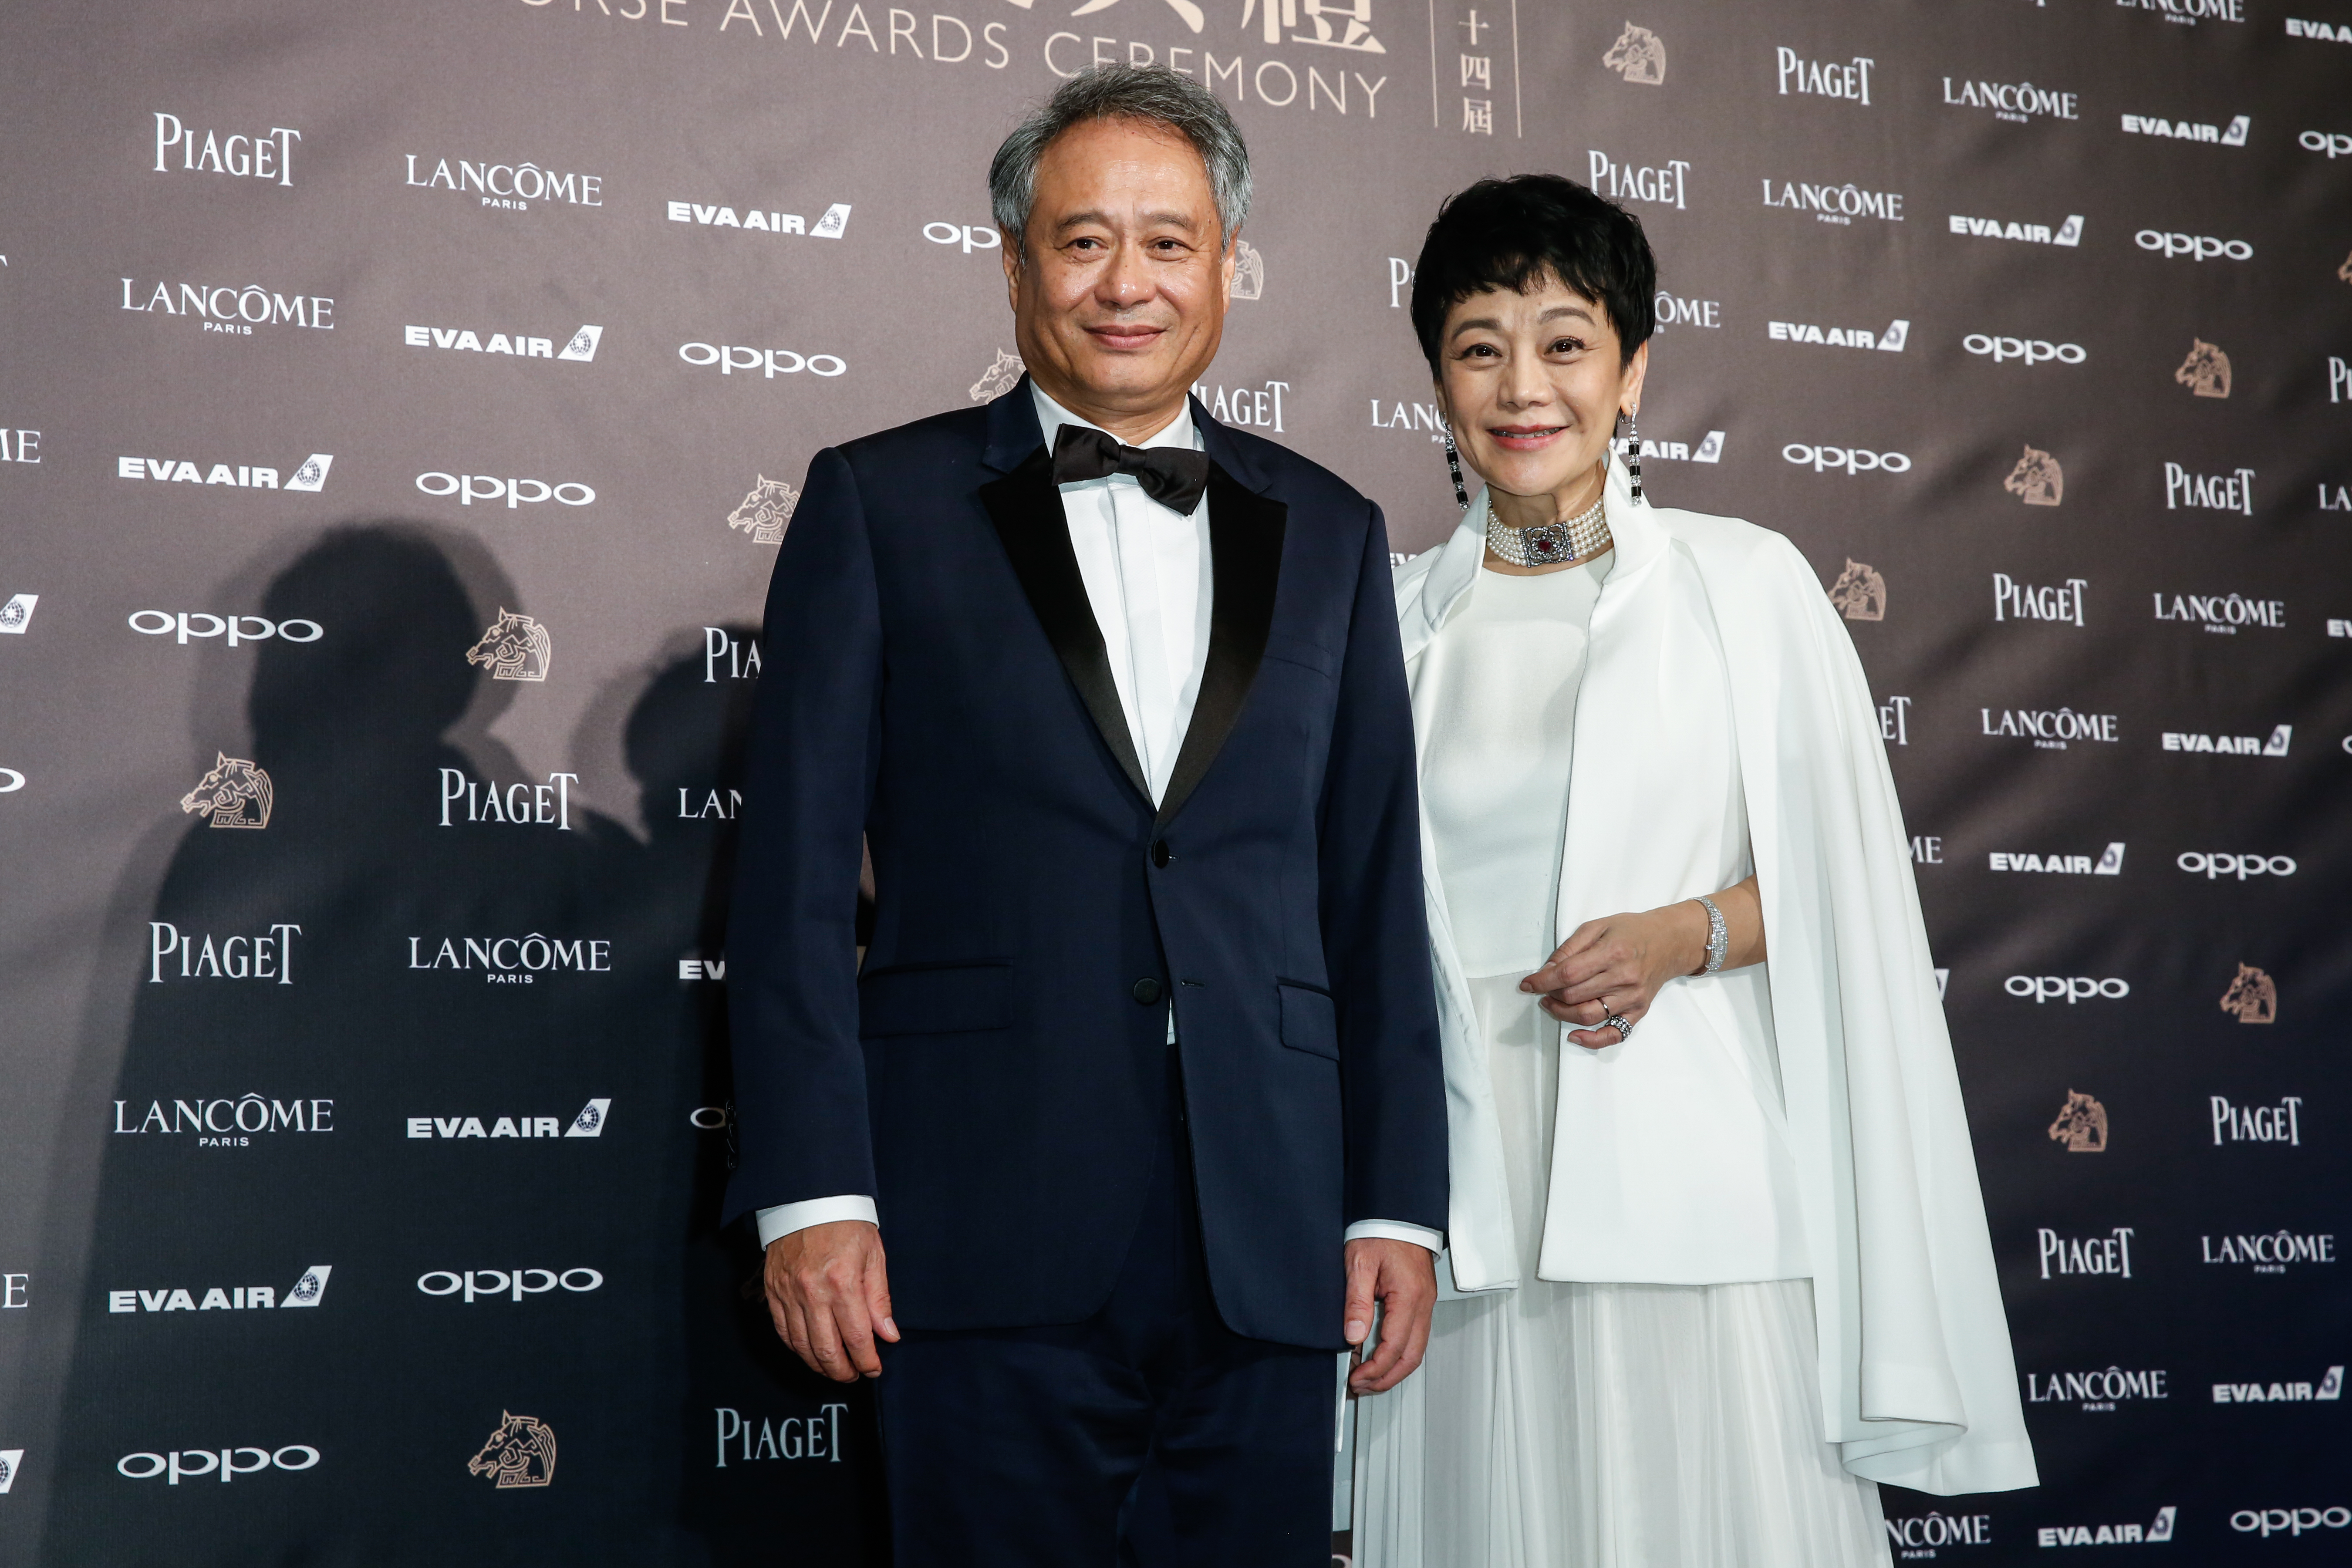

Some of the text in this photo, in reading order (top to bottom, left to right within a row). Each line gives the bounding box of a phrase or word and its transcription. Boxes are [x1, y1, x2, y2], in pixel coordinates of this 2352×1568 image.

[719, 0, 1009, 69] AWARDS
[1943, 77, 2078, 119] LANCÔME
[2299, 131, 2352, 159] op
[406, 154, 602, 206] LANCÔME
[482, 197, 527, 211] PARIS
[1763, 179, 1903, 221] LANCÔME
[1817, 213, 1851, 225] PARIS
[922, 221, 1001, 254] op
[2135, 229, 2253, 261] oppo
[121, 278, 334, 329] LANCÔME
[204, 321, 252, 335] PARIS
[679, 342, 847, 378] oppo
[1963, 334, 2086, 365] oppo
[1782, 443, 1911, 475] oppo
[416, 472, 596, 509] oppo
[2154, 593, 2285, 627] LANCÔME
[128, 610, 323, 647] oppo
[1981, 707, 2119, 742] LANCÔME
[2177, 852, 2297, 880] oppo
[408, 932, 611, 971] LANCÔME
[487, 974, 533, 984] PARIS
[2004, 975, 2129, 1004] oppo
[114, 1092, 333, 1133] LANCÔME
[199, 1137, 249, 1147] PARIS
[2202, 1230, 2335, 1263] LANCÔME
[417, 1268, 603, 1303] oppo
[2028, 1366, 2167, 1402] LANCÔME
[117, 1445, 320, 1485] oppo
[1884, 1511, 1991, 1547] NCÔME
[2230, 1507, 2352, 1538] oppo
[1901, 1549, 1936, 1558] PARIS
